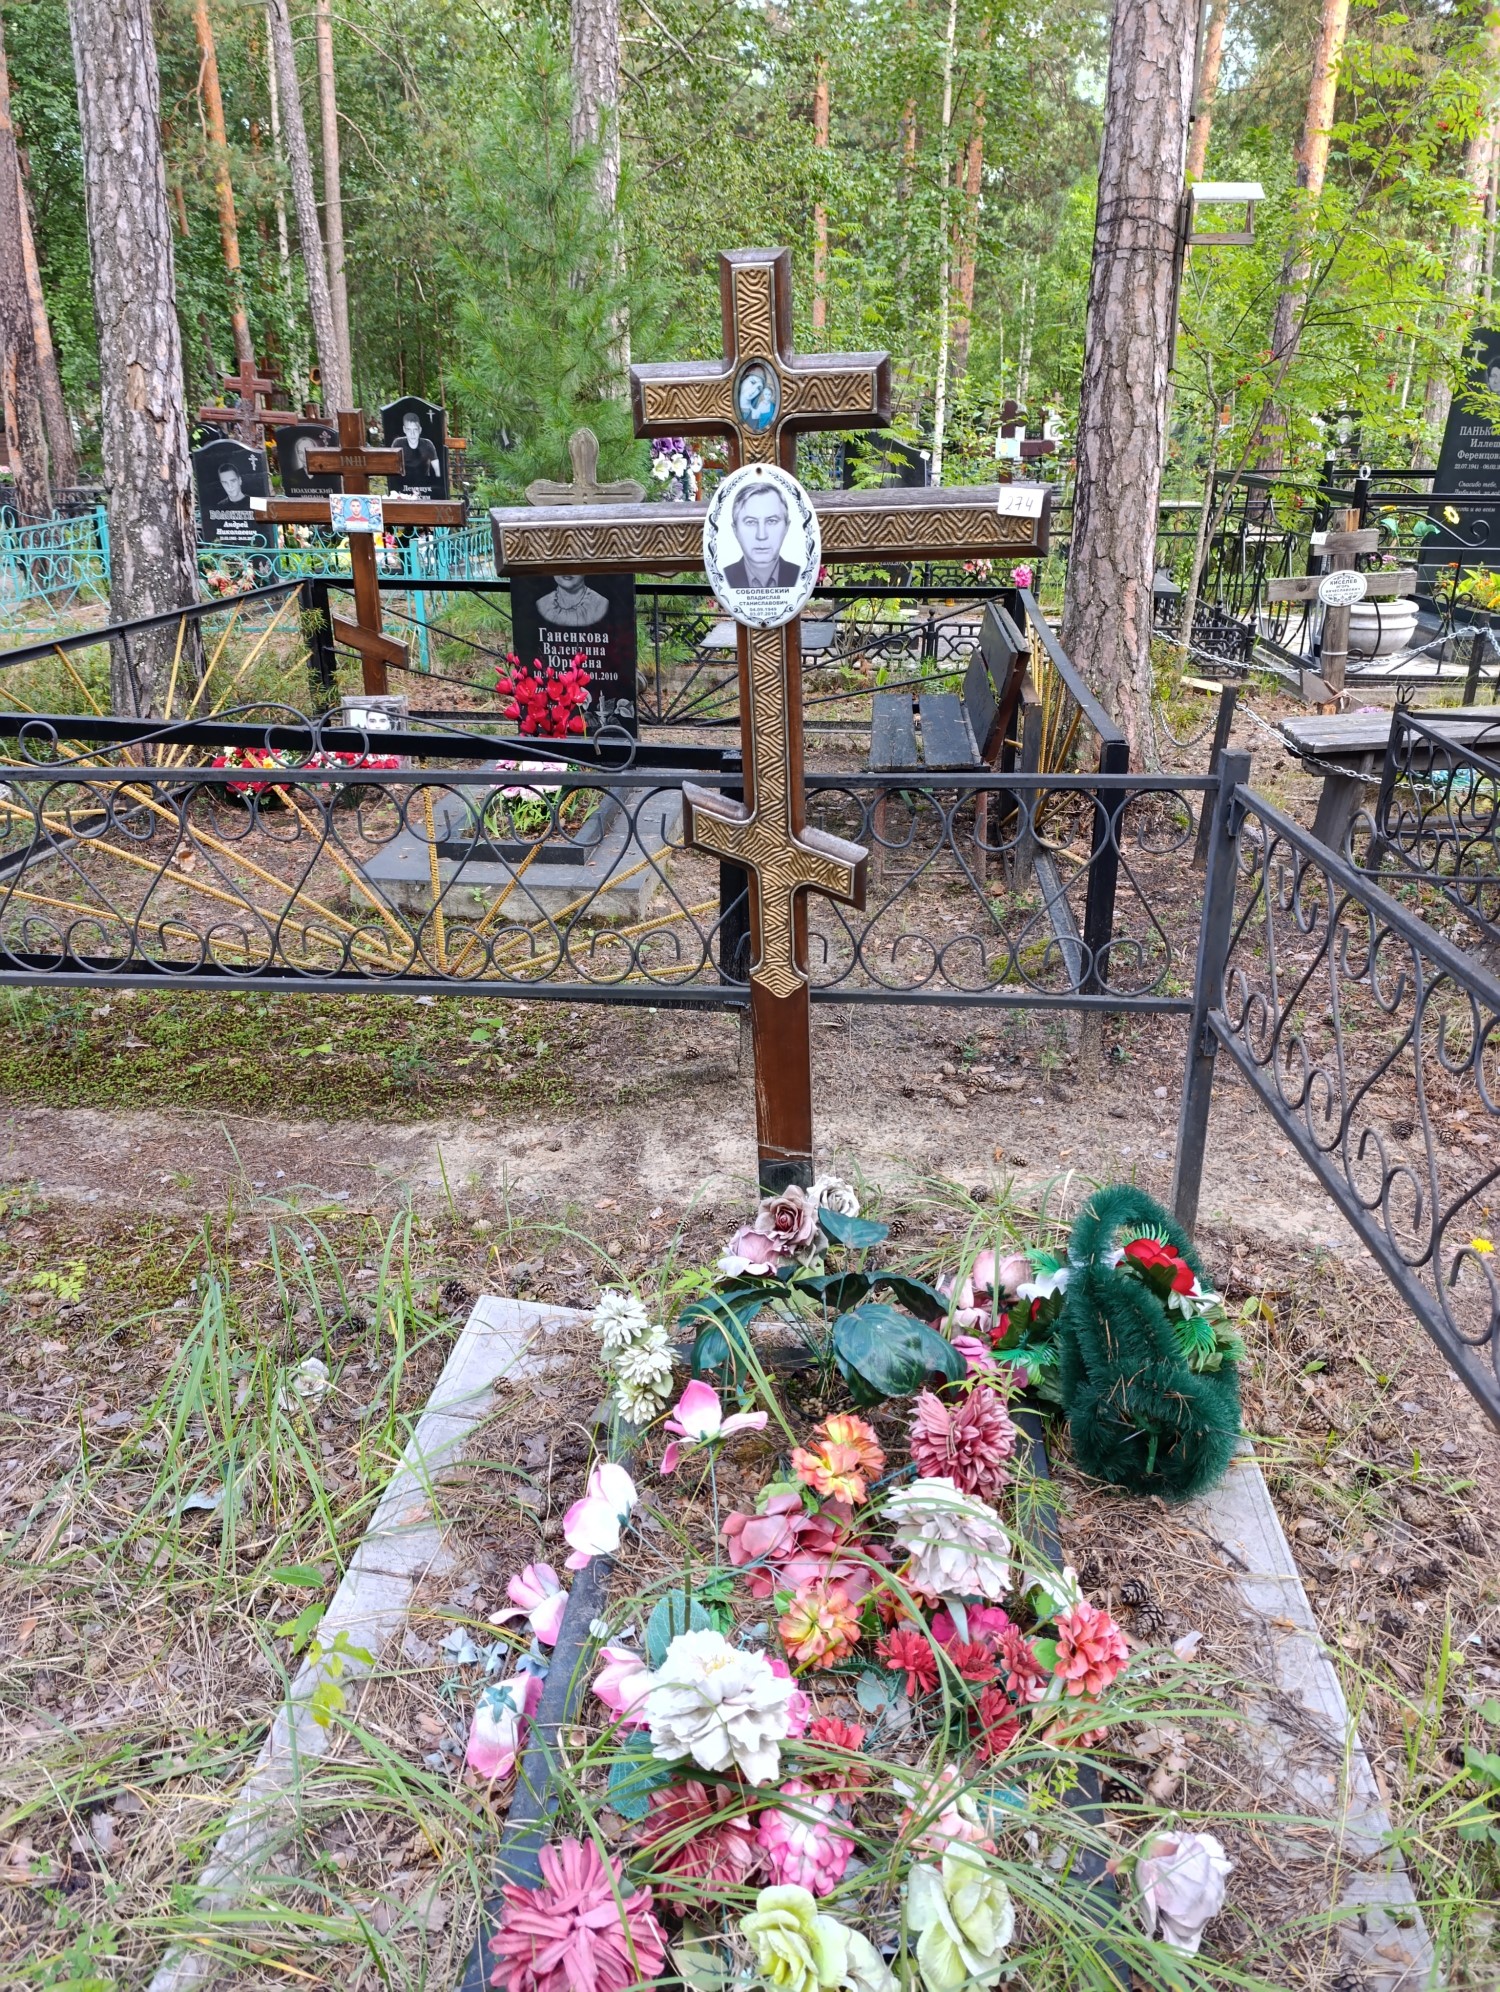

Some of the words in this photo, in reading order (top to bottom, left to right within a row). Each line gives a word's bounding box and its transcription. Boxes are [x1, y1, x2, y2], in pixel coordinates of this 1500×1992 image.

[1457, 450, 1500, 461] Ференцов
[1005, 495, 1034, 512] 274
[223, 520, 249, 530] Андрей
[538, 628, 609, 643] Ганенкова
